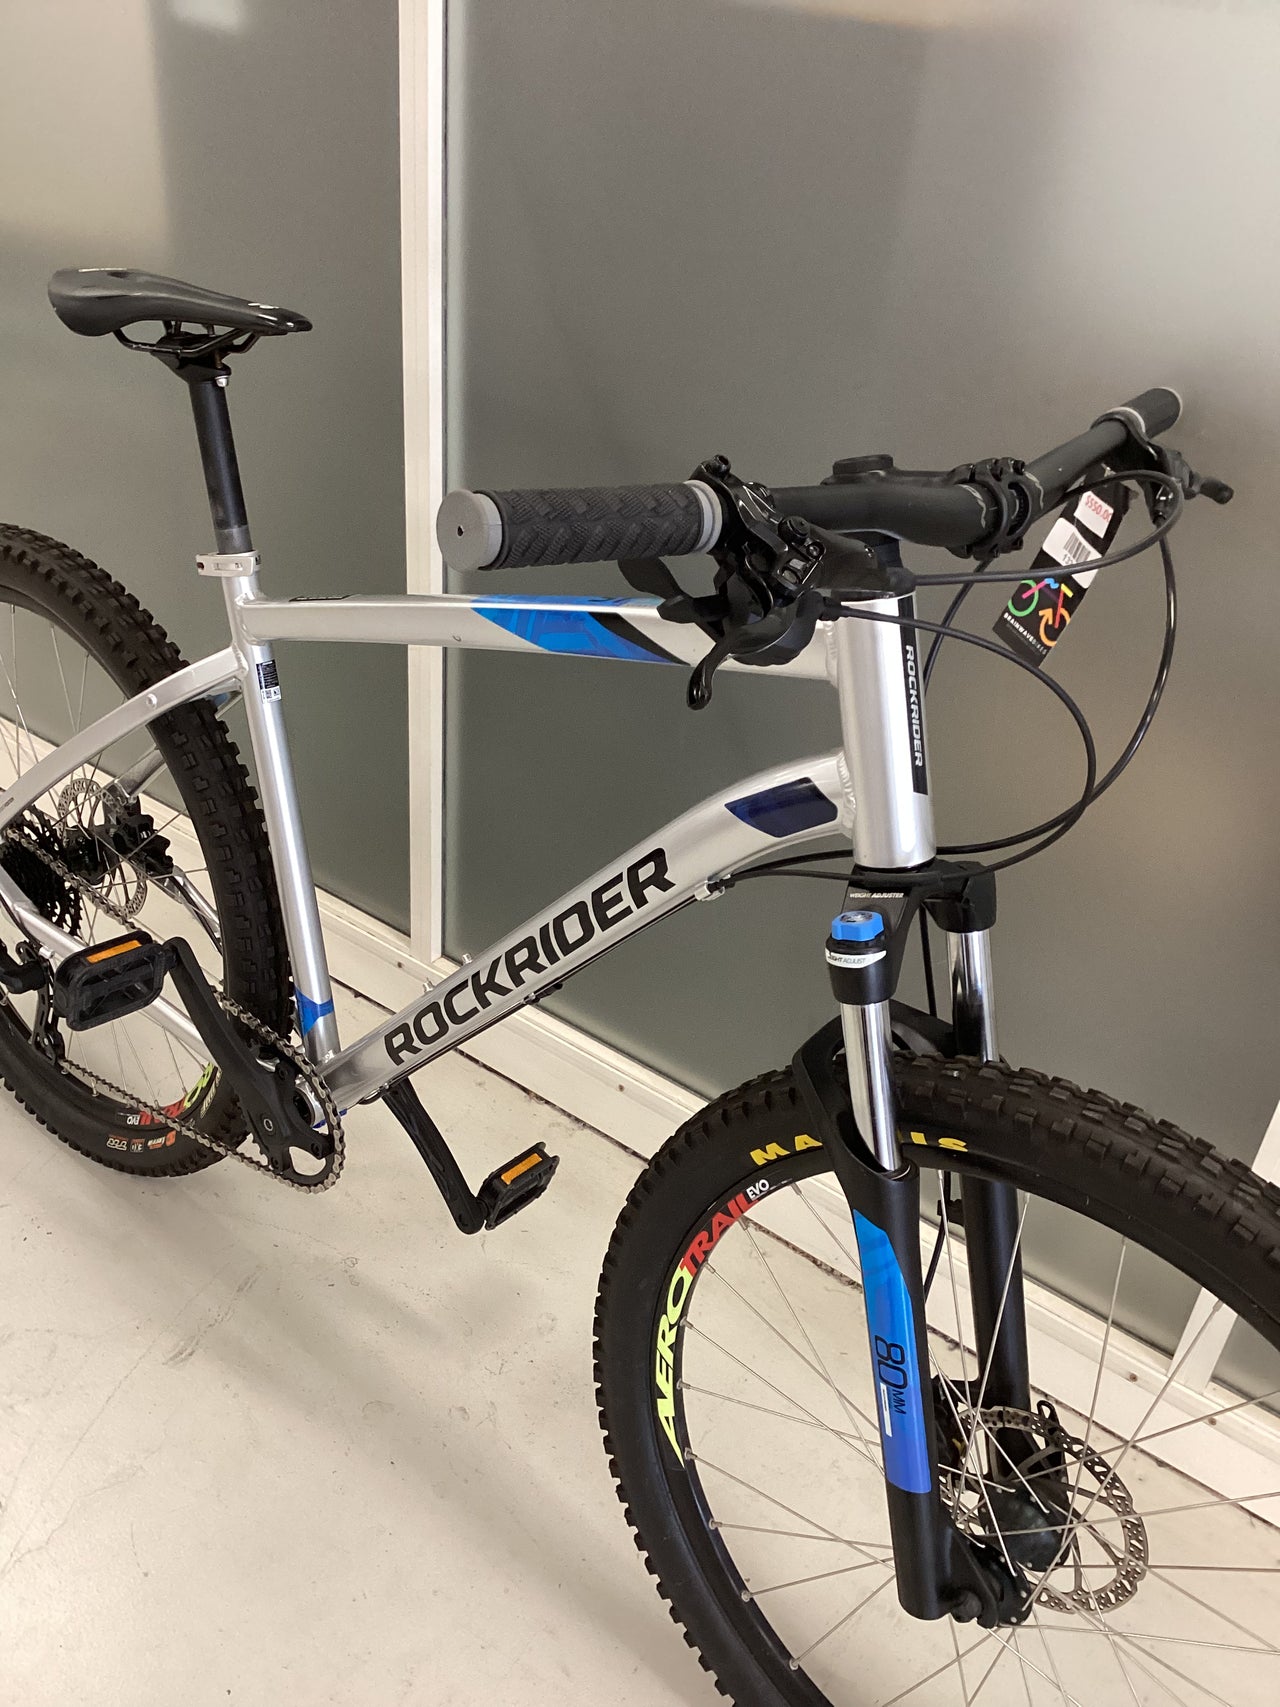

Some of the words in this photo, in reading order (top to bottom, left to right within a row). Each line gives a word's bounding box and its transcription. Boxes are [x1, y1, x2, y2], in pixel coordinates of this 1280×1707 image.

[905, 644, 923, 767] ROCKRIDER
[384, 847, 676, 1066] ROCKRIDER
[750, 1134, 969, 1166] MAIS
[746, 1179, 770, 1200] EVO
